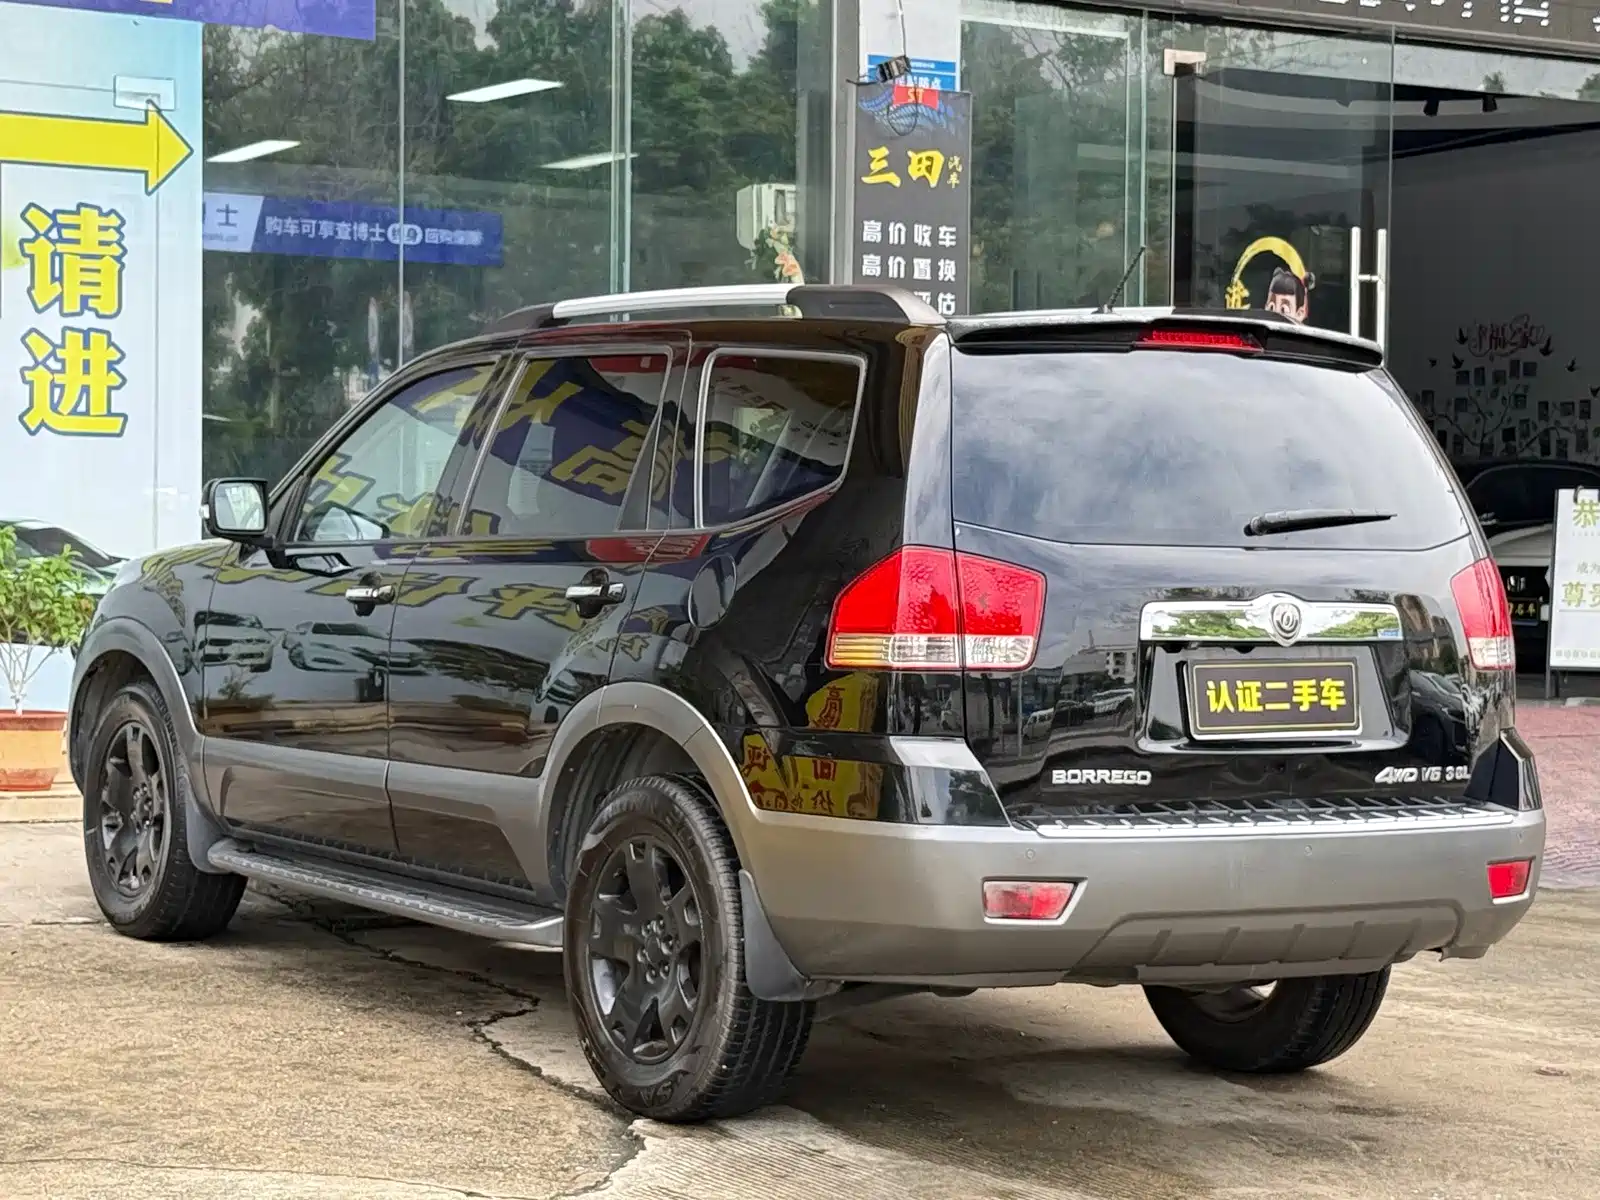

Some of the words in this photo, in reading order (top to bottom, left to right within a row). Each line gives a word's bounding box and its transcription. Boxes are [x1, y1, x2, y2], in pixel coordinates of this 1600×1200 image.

[861, 146, 945, 188] 三田
[947, 155, 963, 188] 汽车
[862, 220, 957, 247] 高价收车
[862, 254, 956, 282] 高价置换
[20, 203, 127, 436] 请进
[1205, 678, 1347, 713] 认证二手车
[1052, 769, 1152, 785] BORREGO
[1375, 766, 1418, 784] 4WD
[1421, 766, 1442, 782] V6
